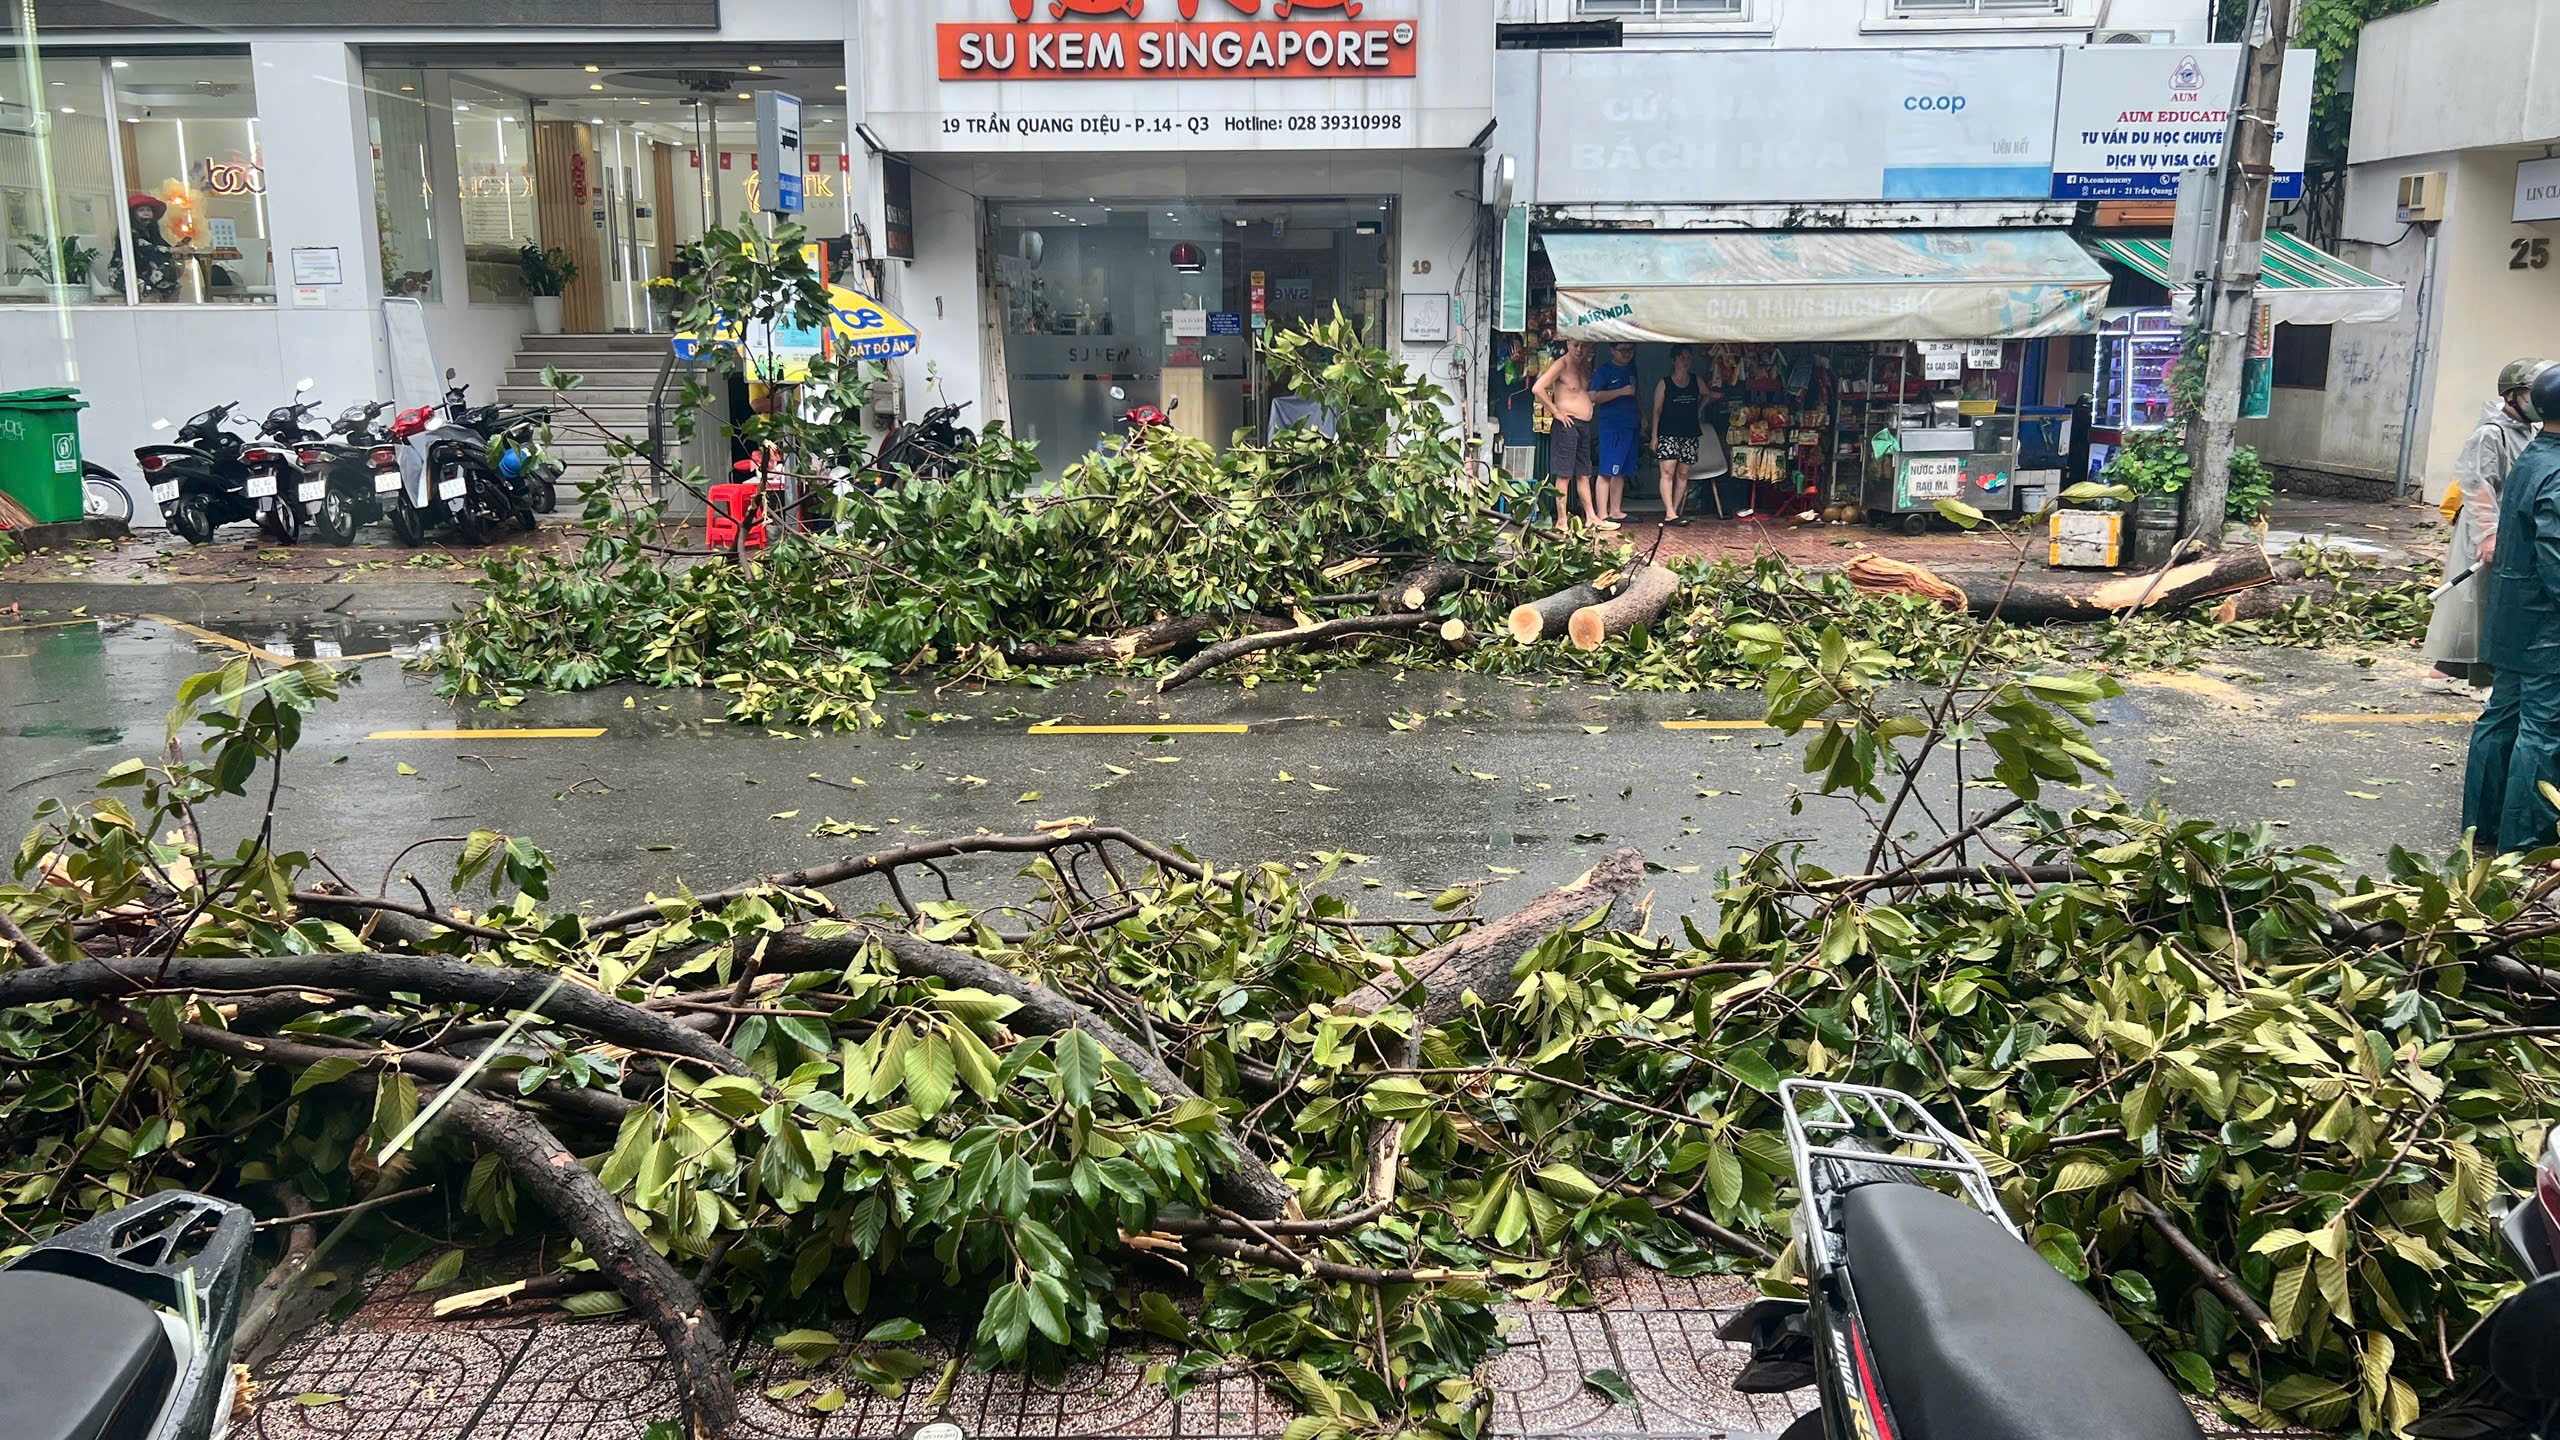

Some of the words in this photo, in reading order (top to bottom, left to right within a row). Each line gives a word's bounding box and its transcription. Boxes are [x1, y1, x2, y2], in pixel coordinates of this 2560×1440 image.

[959, 33, 1015, 70] SU
[1028, 32, 1125, 69] KEM
[1138, 30, 1390, 69] SINGAPORE
[1904, 95, 1966, 114] co.op
[2170, 93, 2198, 102] AUM
[942, 119, 961, 133] 19
[966, 112, 1010, 133] TRẦN
[1017, 118, 1074, 136] QUANG
[1081, 114, 1121, 136] DIỆU
[1135, 118, 1172, 132] P.14
[1187, 117, 1209, 134] Q3
[1225, 116, 1284, 131] Hotline:
[1287, 116, 1317, 131] 028
[1320, 115, 1402, 130] 39310998
[2117, 111, 2154, 123] AUM
[2081, 131, 2099, 144] TƯ
[2101, 127, 2128, 144] VẤN
[2131, 131, 2150, 144] DU
[2153, 131, 2180, 147] HỌC
[2183, 129, 2225, 144] CHUYÊ
[2106, 154, 2137, 170] DỊCH
[2140, 154, 2158, 170] VỤ
[2161, 154, 2190, 167] VISA
[2193, 152, 2216, 167] CÁC
[2150, 188, 2173, 197] Quang
[2526, 186, 2544, 200] LIN
[2509, 238, 2551, 270] 25
[1412, 260, 1432, 275] 19
